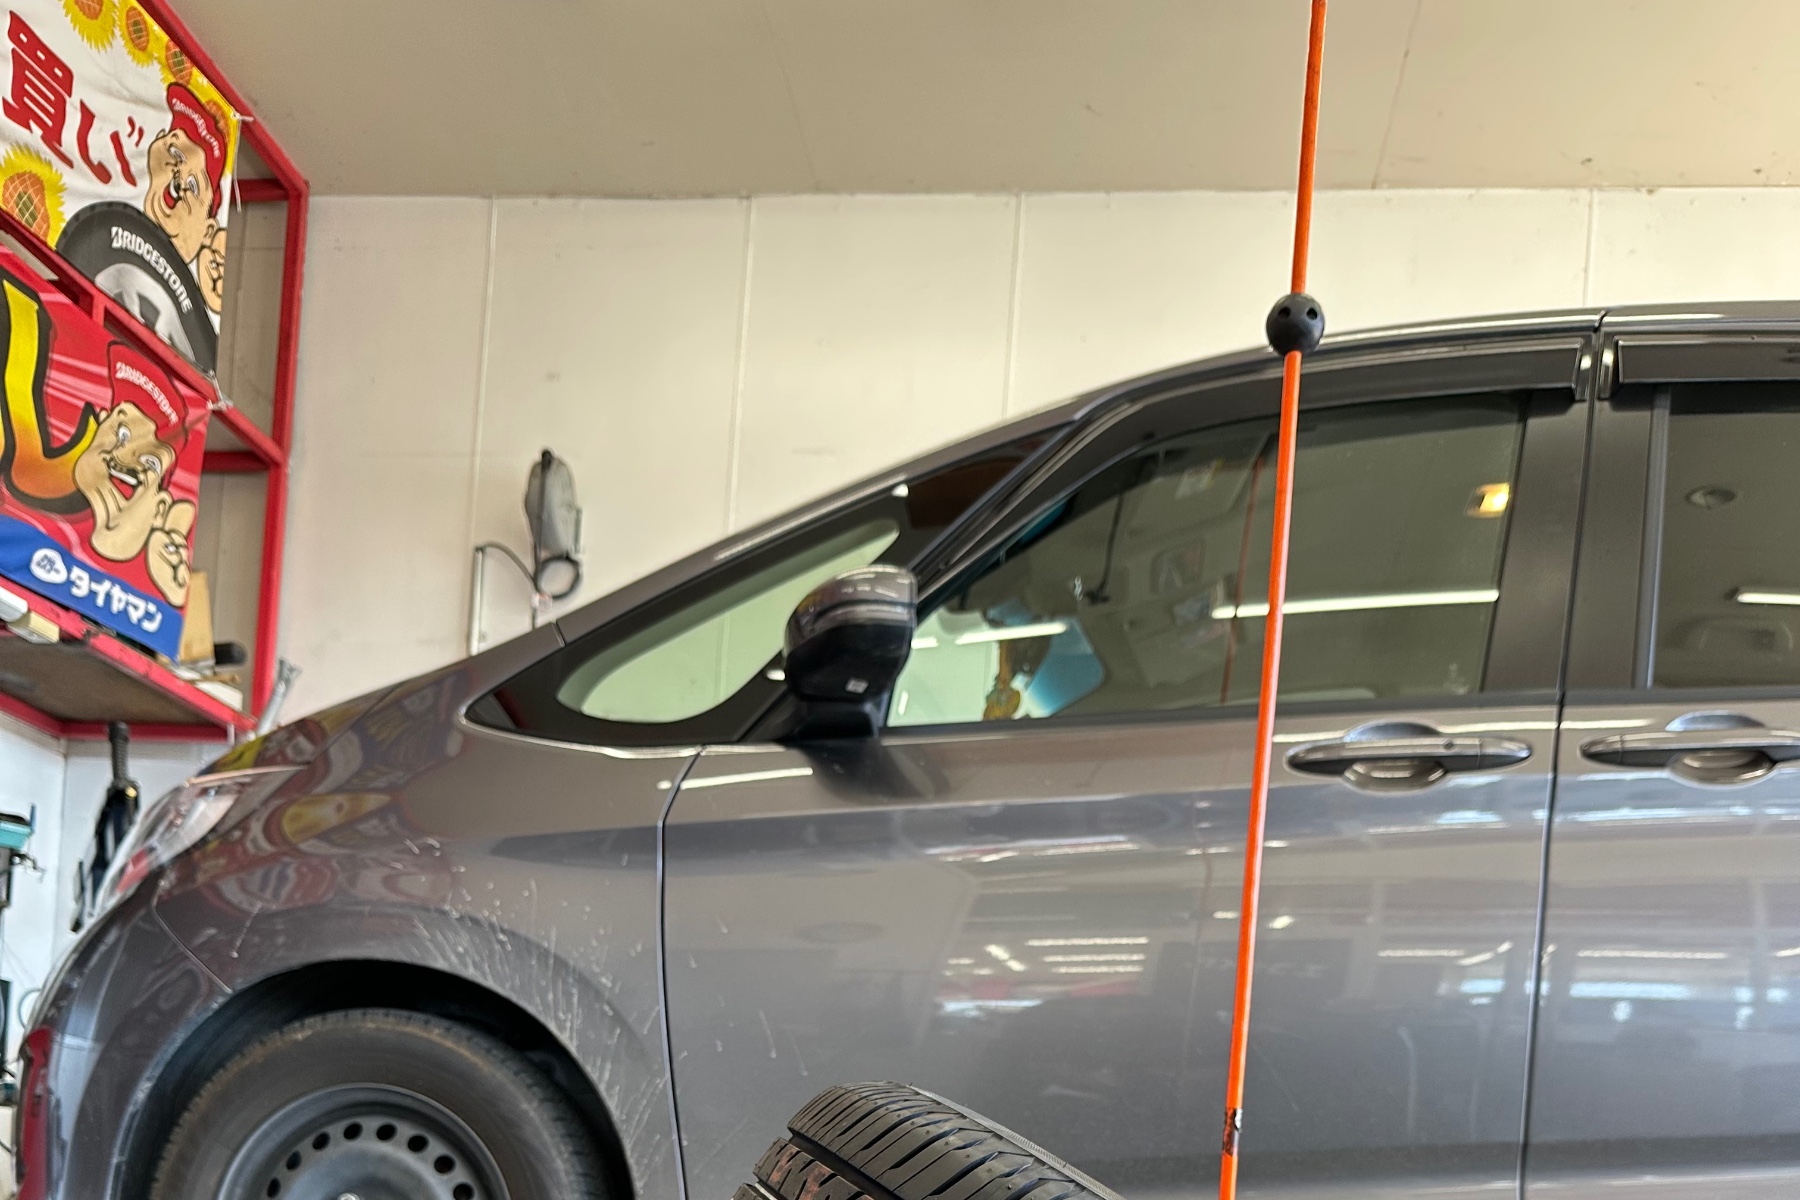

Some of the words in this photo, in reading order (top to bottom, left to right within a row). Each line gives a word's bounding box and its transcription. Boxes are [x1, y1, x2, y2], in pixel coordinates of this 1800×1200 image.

[111, 226, 193, 314] BRIDGESTONE
[115, 361, 179, 425] BRIDGESTONE
[69, 565, 162, 632] タイヤマン
